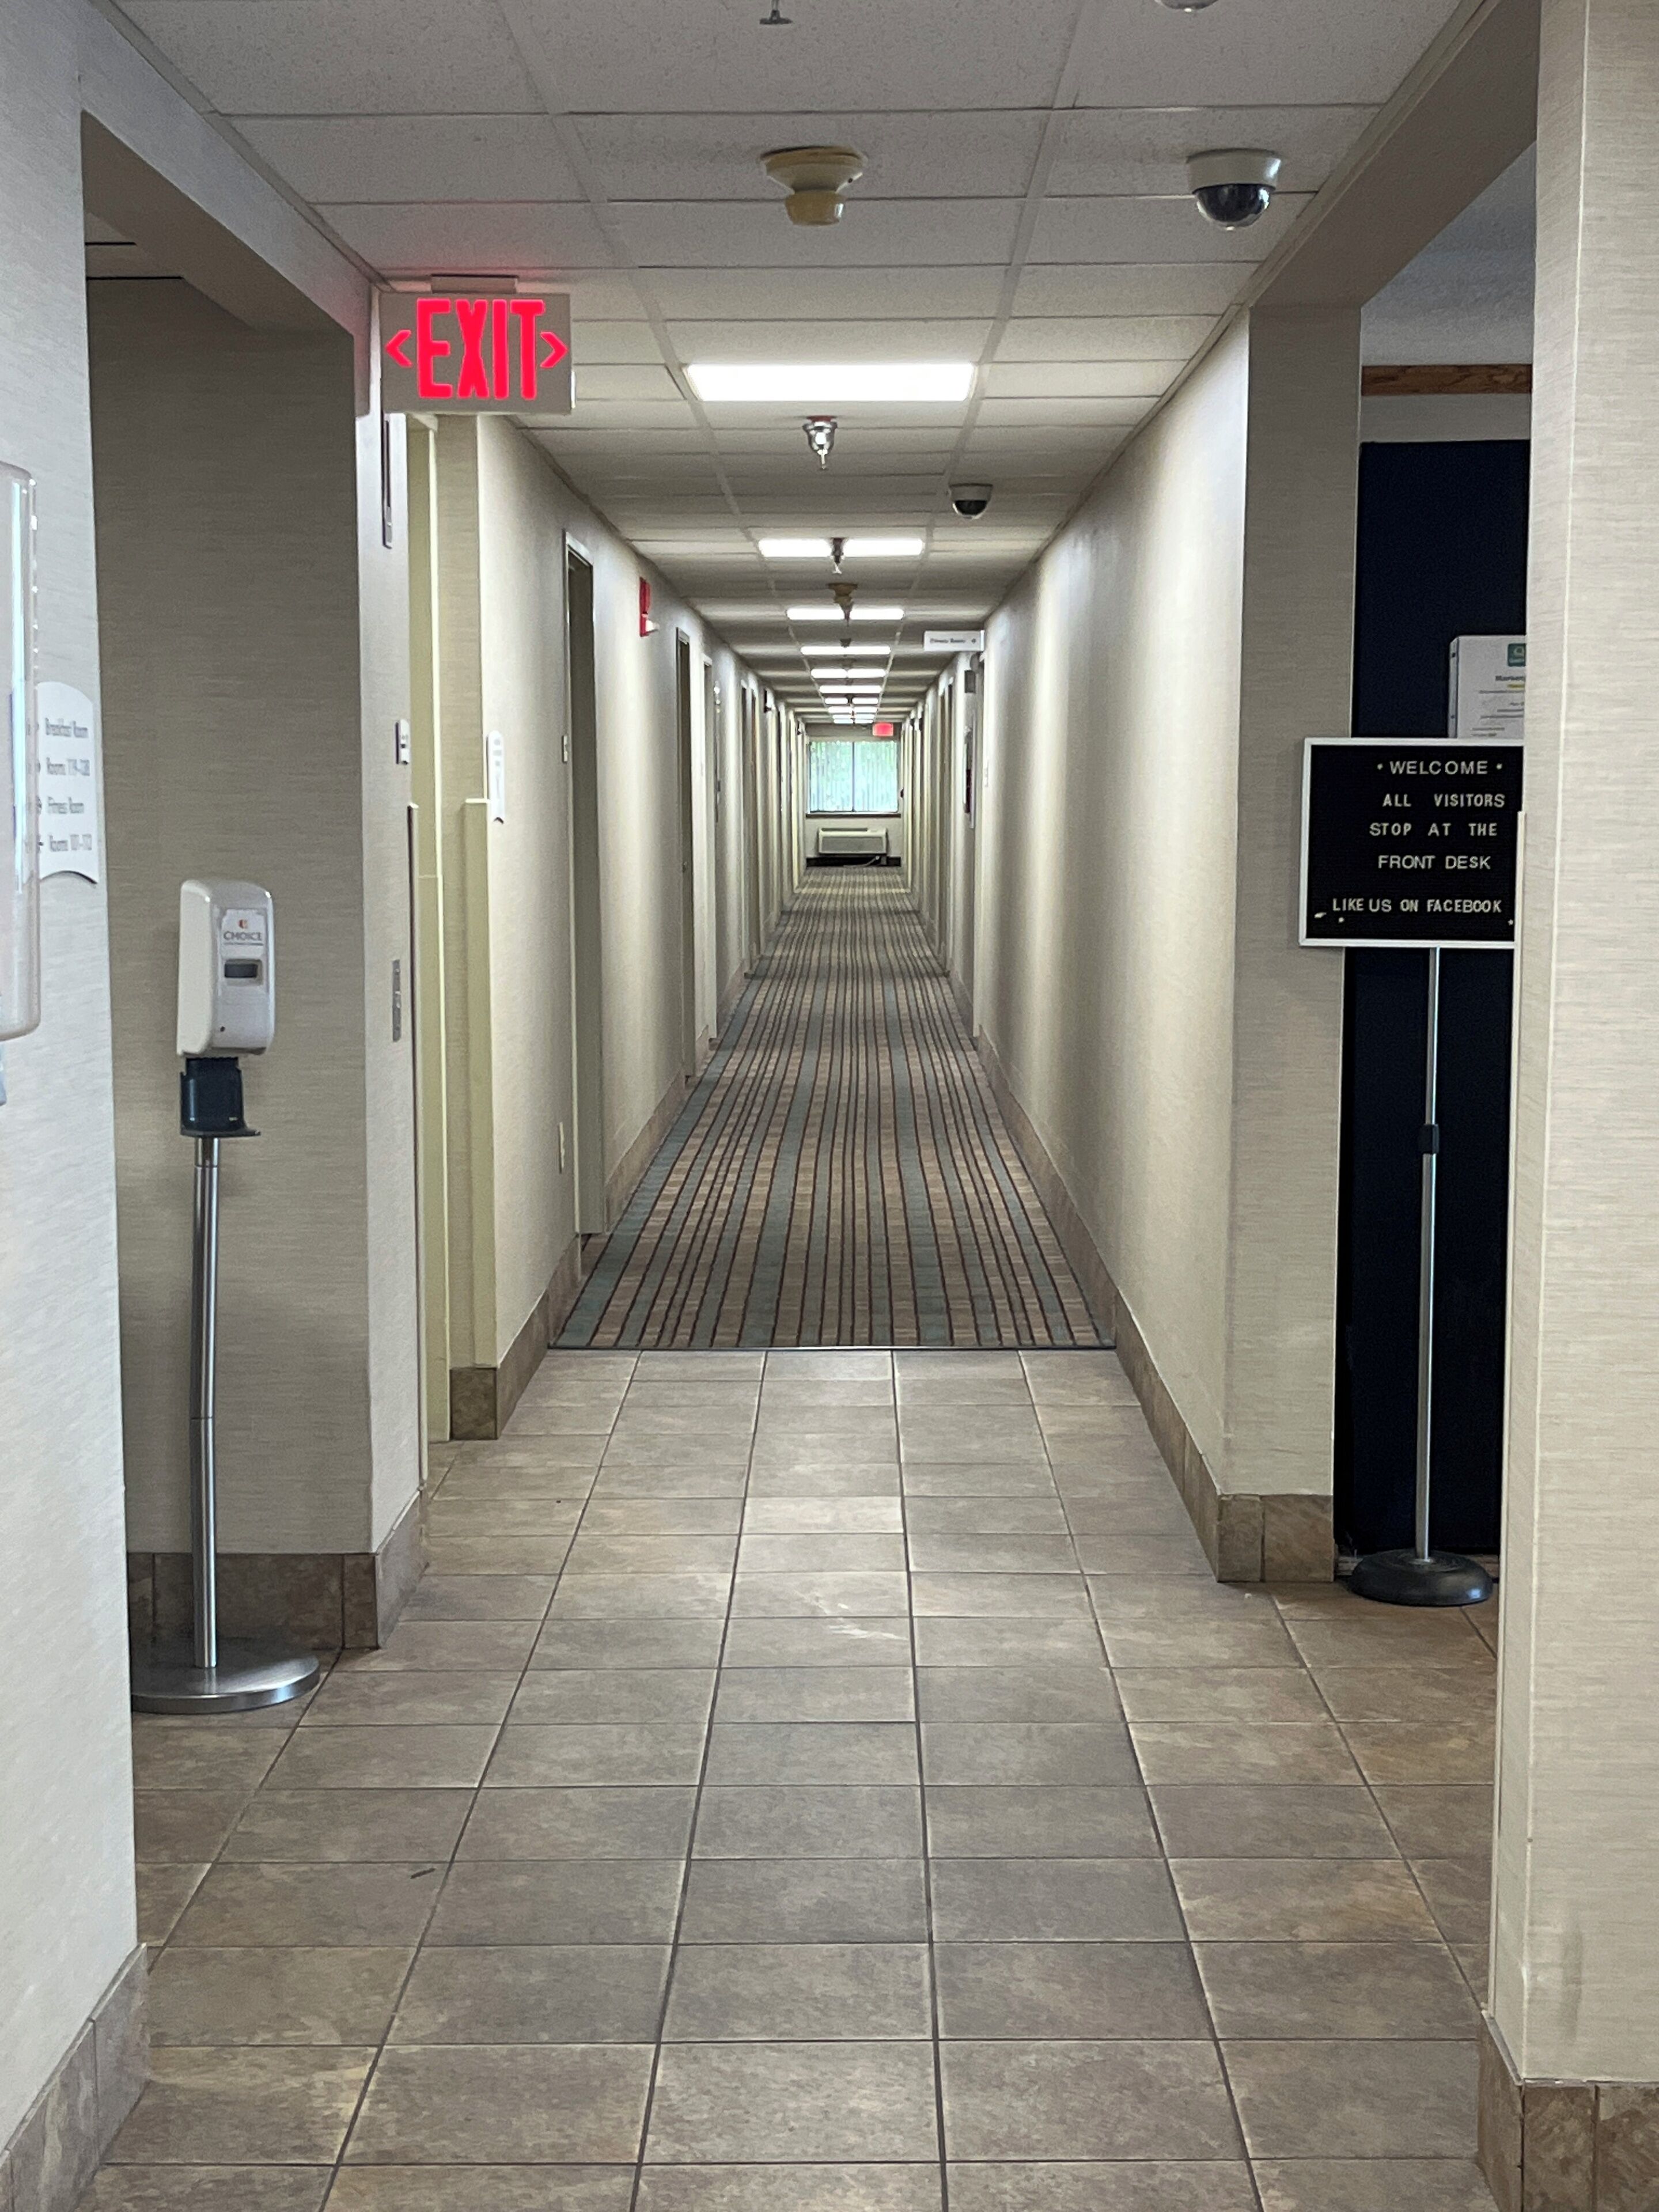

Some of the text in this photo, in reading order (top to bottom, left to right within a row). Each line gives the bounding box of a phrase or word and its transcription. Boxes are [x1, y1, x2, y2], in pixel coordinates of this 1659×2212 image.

[416, 297, 545, 399] EXIT
[1389, 761, 1488, 775] WELCOME
[1382, 794, 1505, 808] ALL VISITORS
[1369, 823, 1498, 836] STOP AT THE
[1378, 855, 1491, 869] FRONT DESK
[1332, 898, 1502, 913] LIKE US ON FACEBOOK
